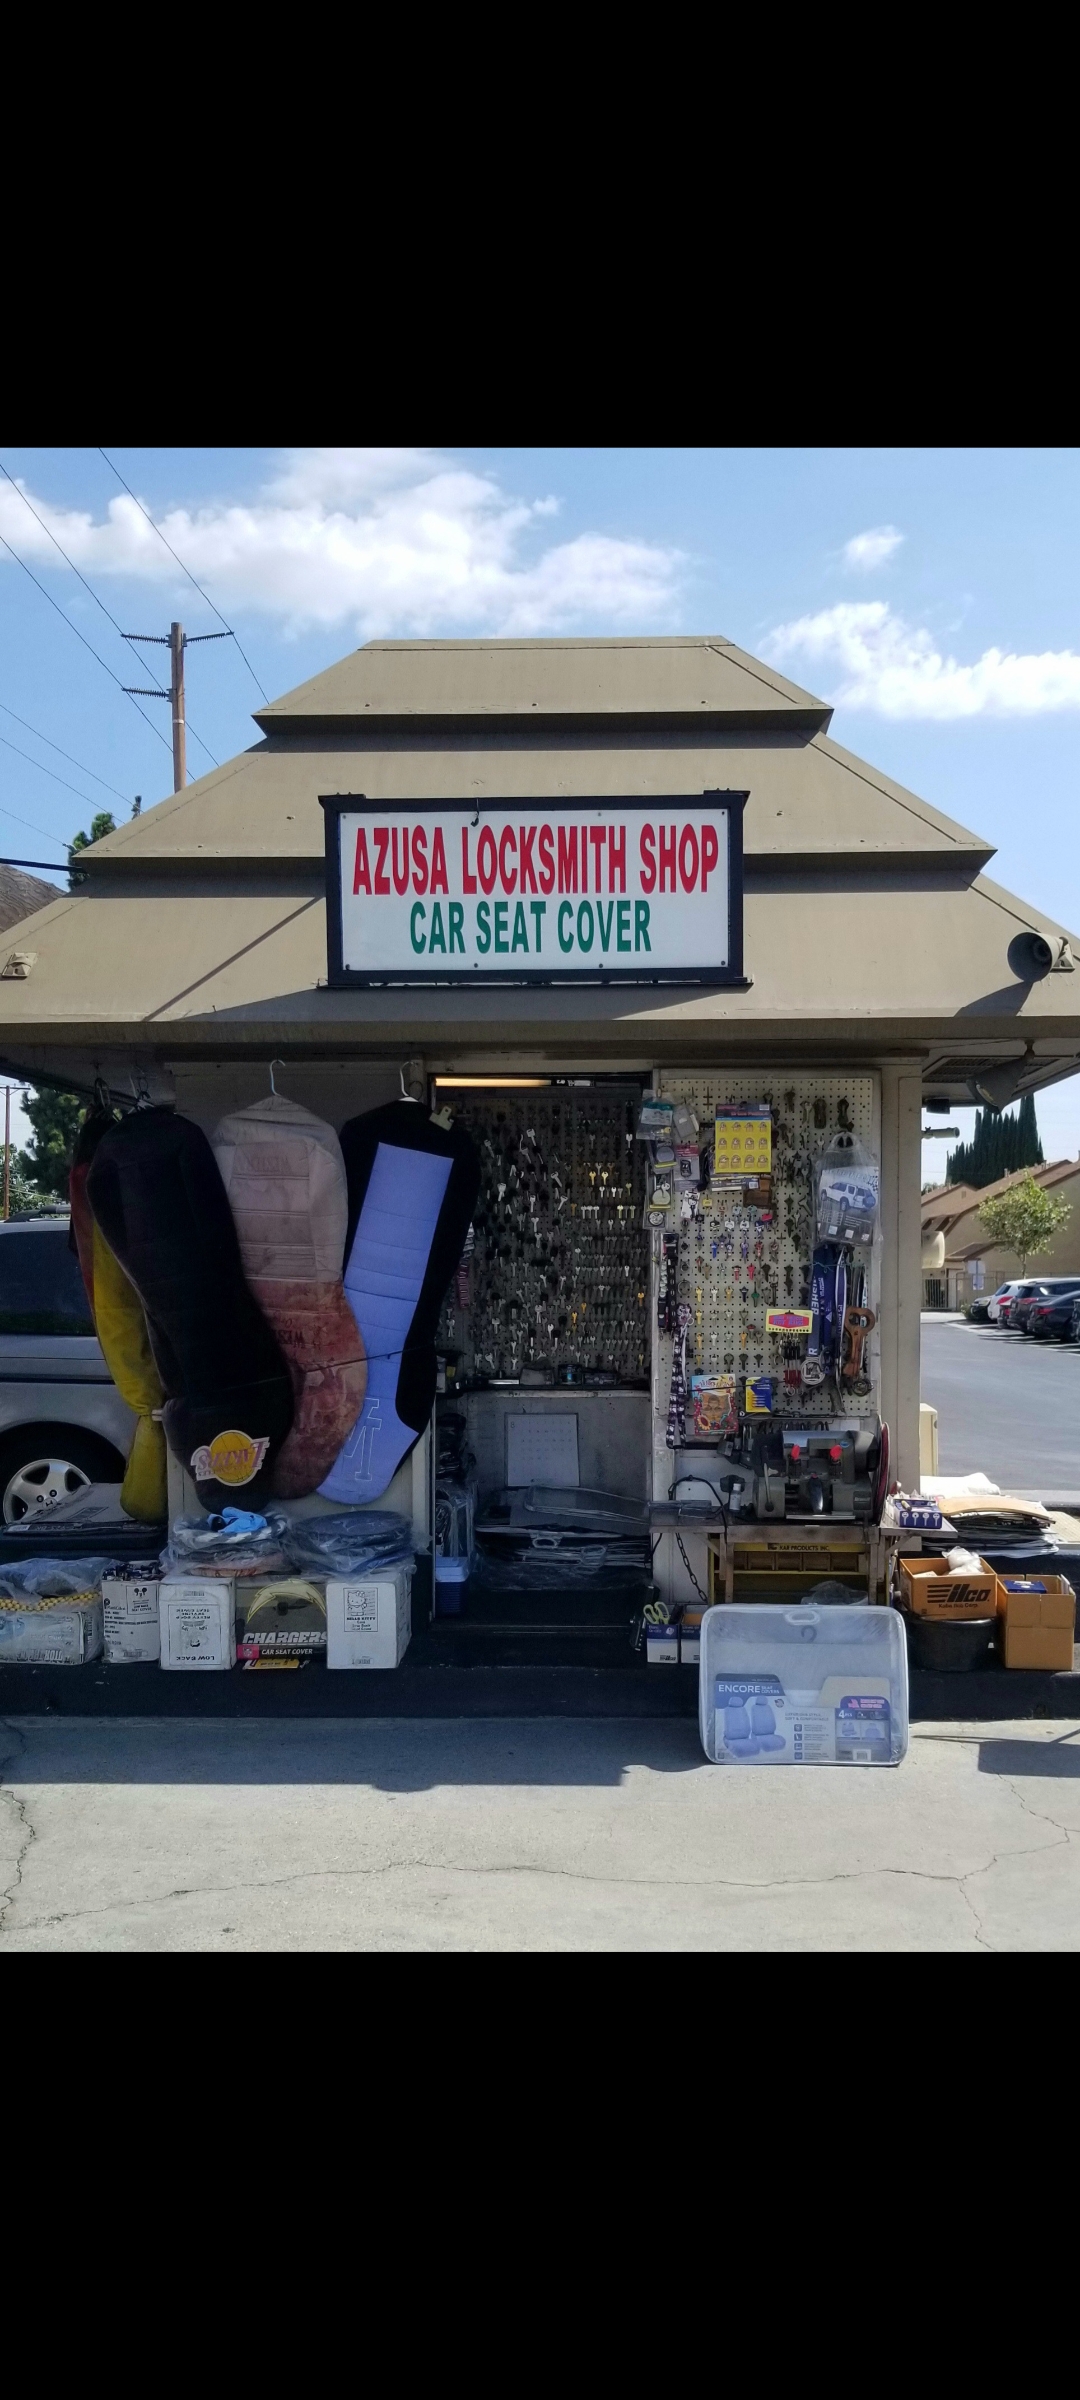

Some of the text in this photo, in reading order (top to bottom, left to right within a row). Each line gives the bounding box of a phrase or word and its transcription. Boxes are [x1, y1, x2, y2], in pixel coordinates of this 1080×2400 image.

[352, 823, 719, 896] AZUSA LOCKSMITH SHOP
[410, 900, 653, 955] CAR SEAT COVER
[242, 1631, 327, 1644] CHARGERS
[718, 1684, 760, 1693] ENCORE
